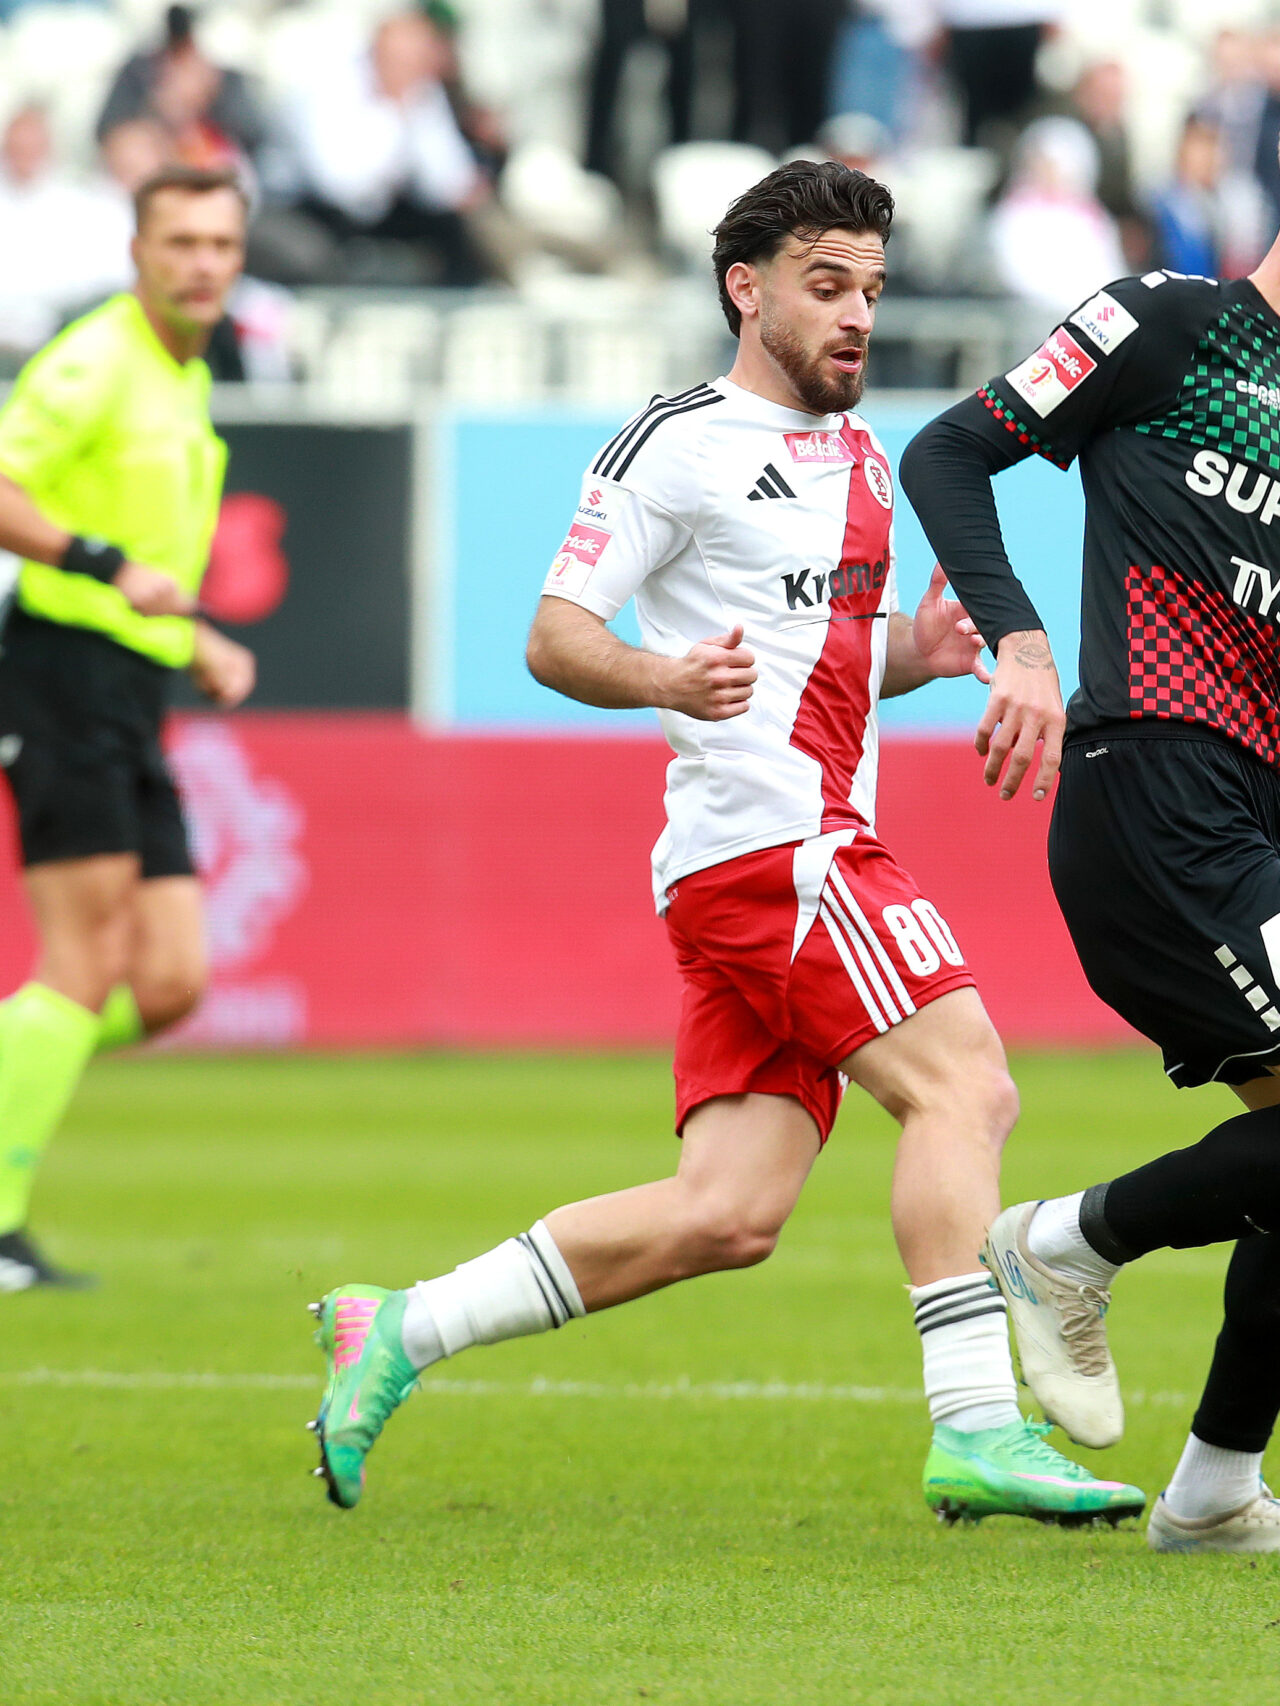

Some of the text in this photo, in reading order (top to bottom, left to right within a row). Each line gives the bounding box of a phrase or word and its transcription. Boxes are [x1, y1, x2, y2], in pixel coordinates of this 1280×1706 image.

[1078, 314, 1110, 346] SZUKI
[794, 440, 843, 457] Betclic
[578, 506, 608, 520] UZUKI
[565, 535, 600, 554] etclic
[882, 898, 964, 977] 80
